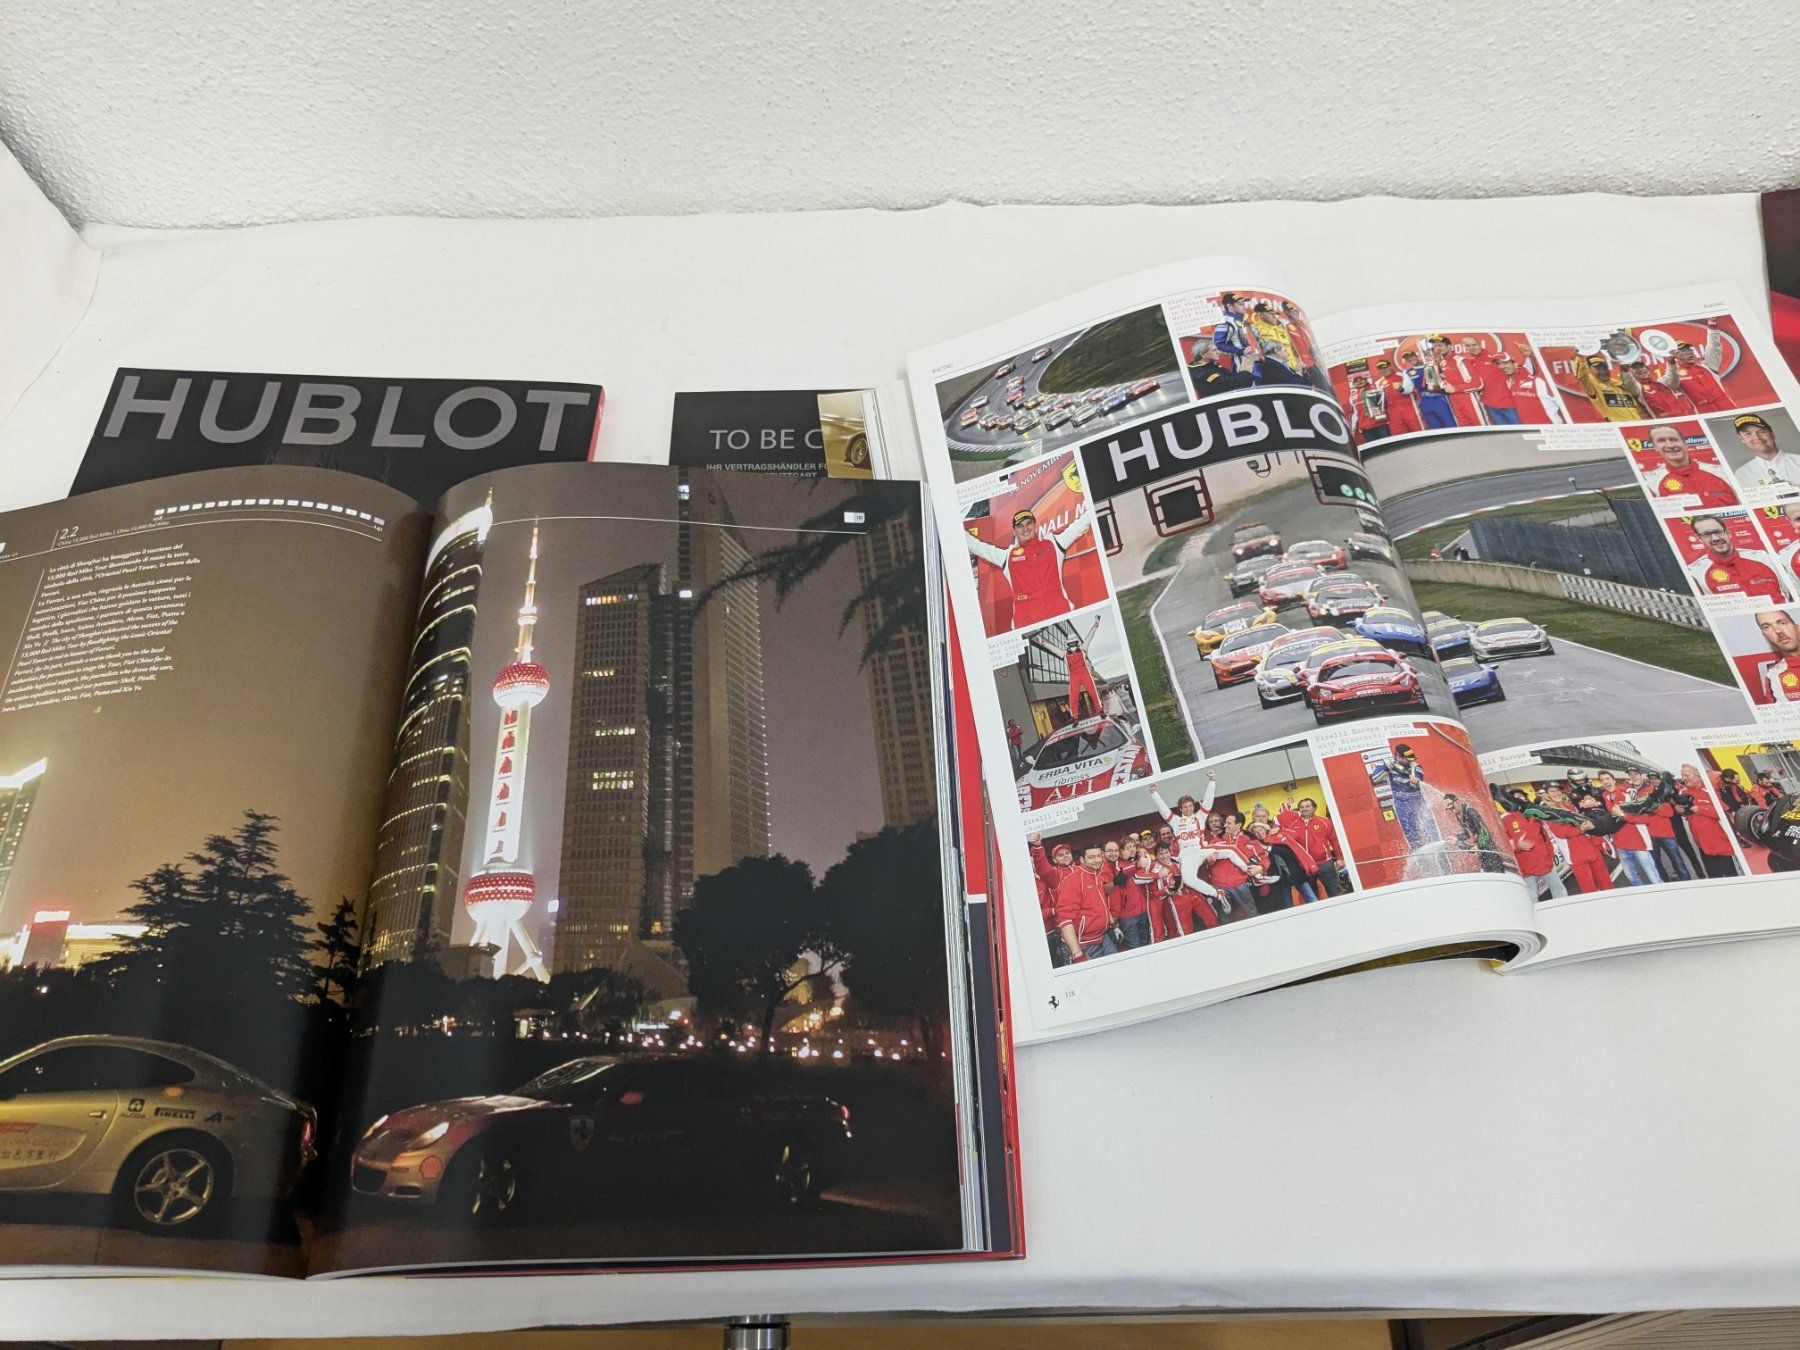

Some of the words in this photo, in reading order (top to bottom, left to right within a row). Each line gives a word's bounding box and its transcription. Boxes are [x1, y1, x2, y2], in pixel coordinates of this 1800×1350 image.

[103, 375, 590, 452] HUBLOT
[708, 429, 750, 450] TO
[760, 429, 796, 450] BE
[1108, 400, 1350, 482] HUBLO
[724, 462, 816, 472] VERTRAGSHÄNDLER
[60, 526, 78, 540] 2.2
[1039, 767, 1070, 780] ERBA
[1074, 758, 1103, 770] VITA
[154, 1107, 196, 1120] PIRELLI
